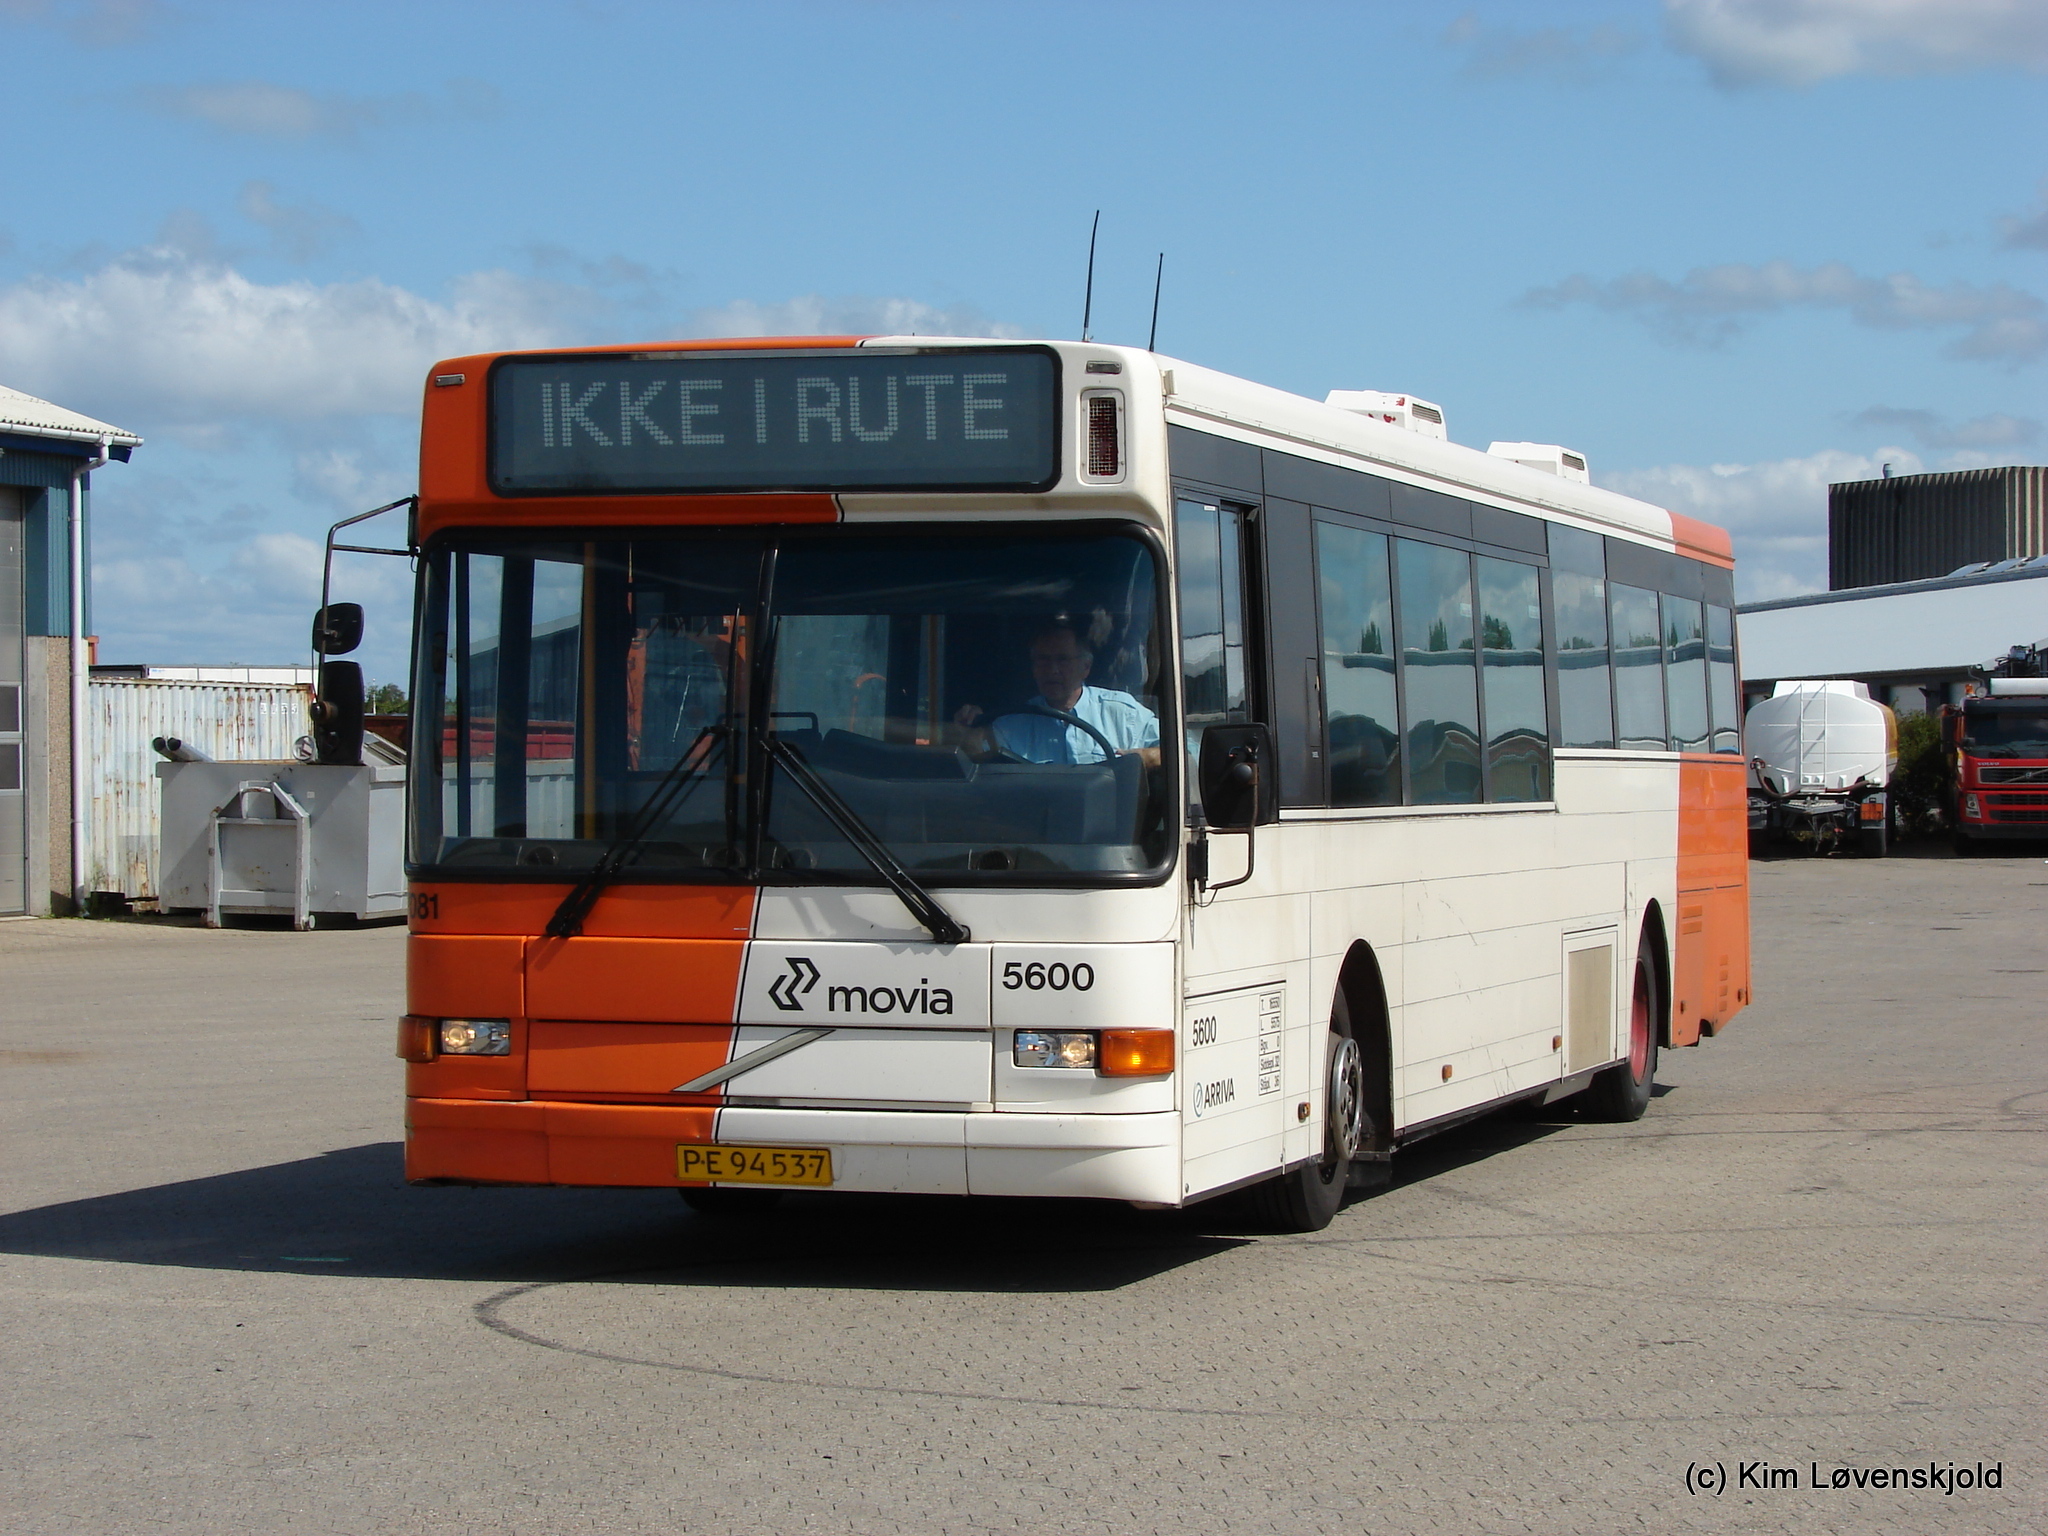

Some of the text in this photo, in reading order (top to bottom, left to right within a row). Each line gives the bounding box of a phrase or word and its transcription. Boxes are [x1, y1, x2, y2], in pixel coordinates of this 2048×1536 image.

[541, 373, 1008, 447] IKKE I RUTE
[1002, 962, 1095, 991] 5600
[828, 978, 953, 1014] movia
[1192, 1015, 1217, 1047] 5600
[1204, 1077, 1235, 1109] ARRIVA
